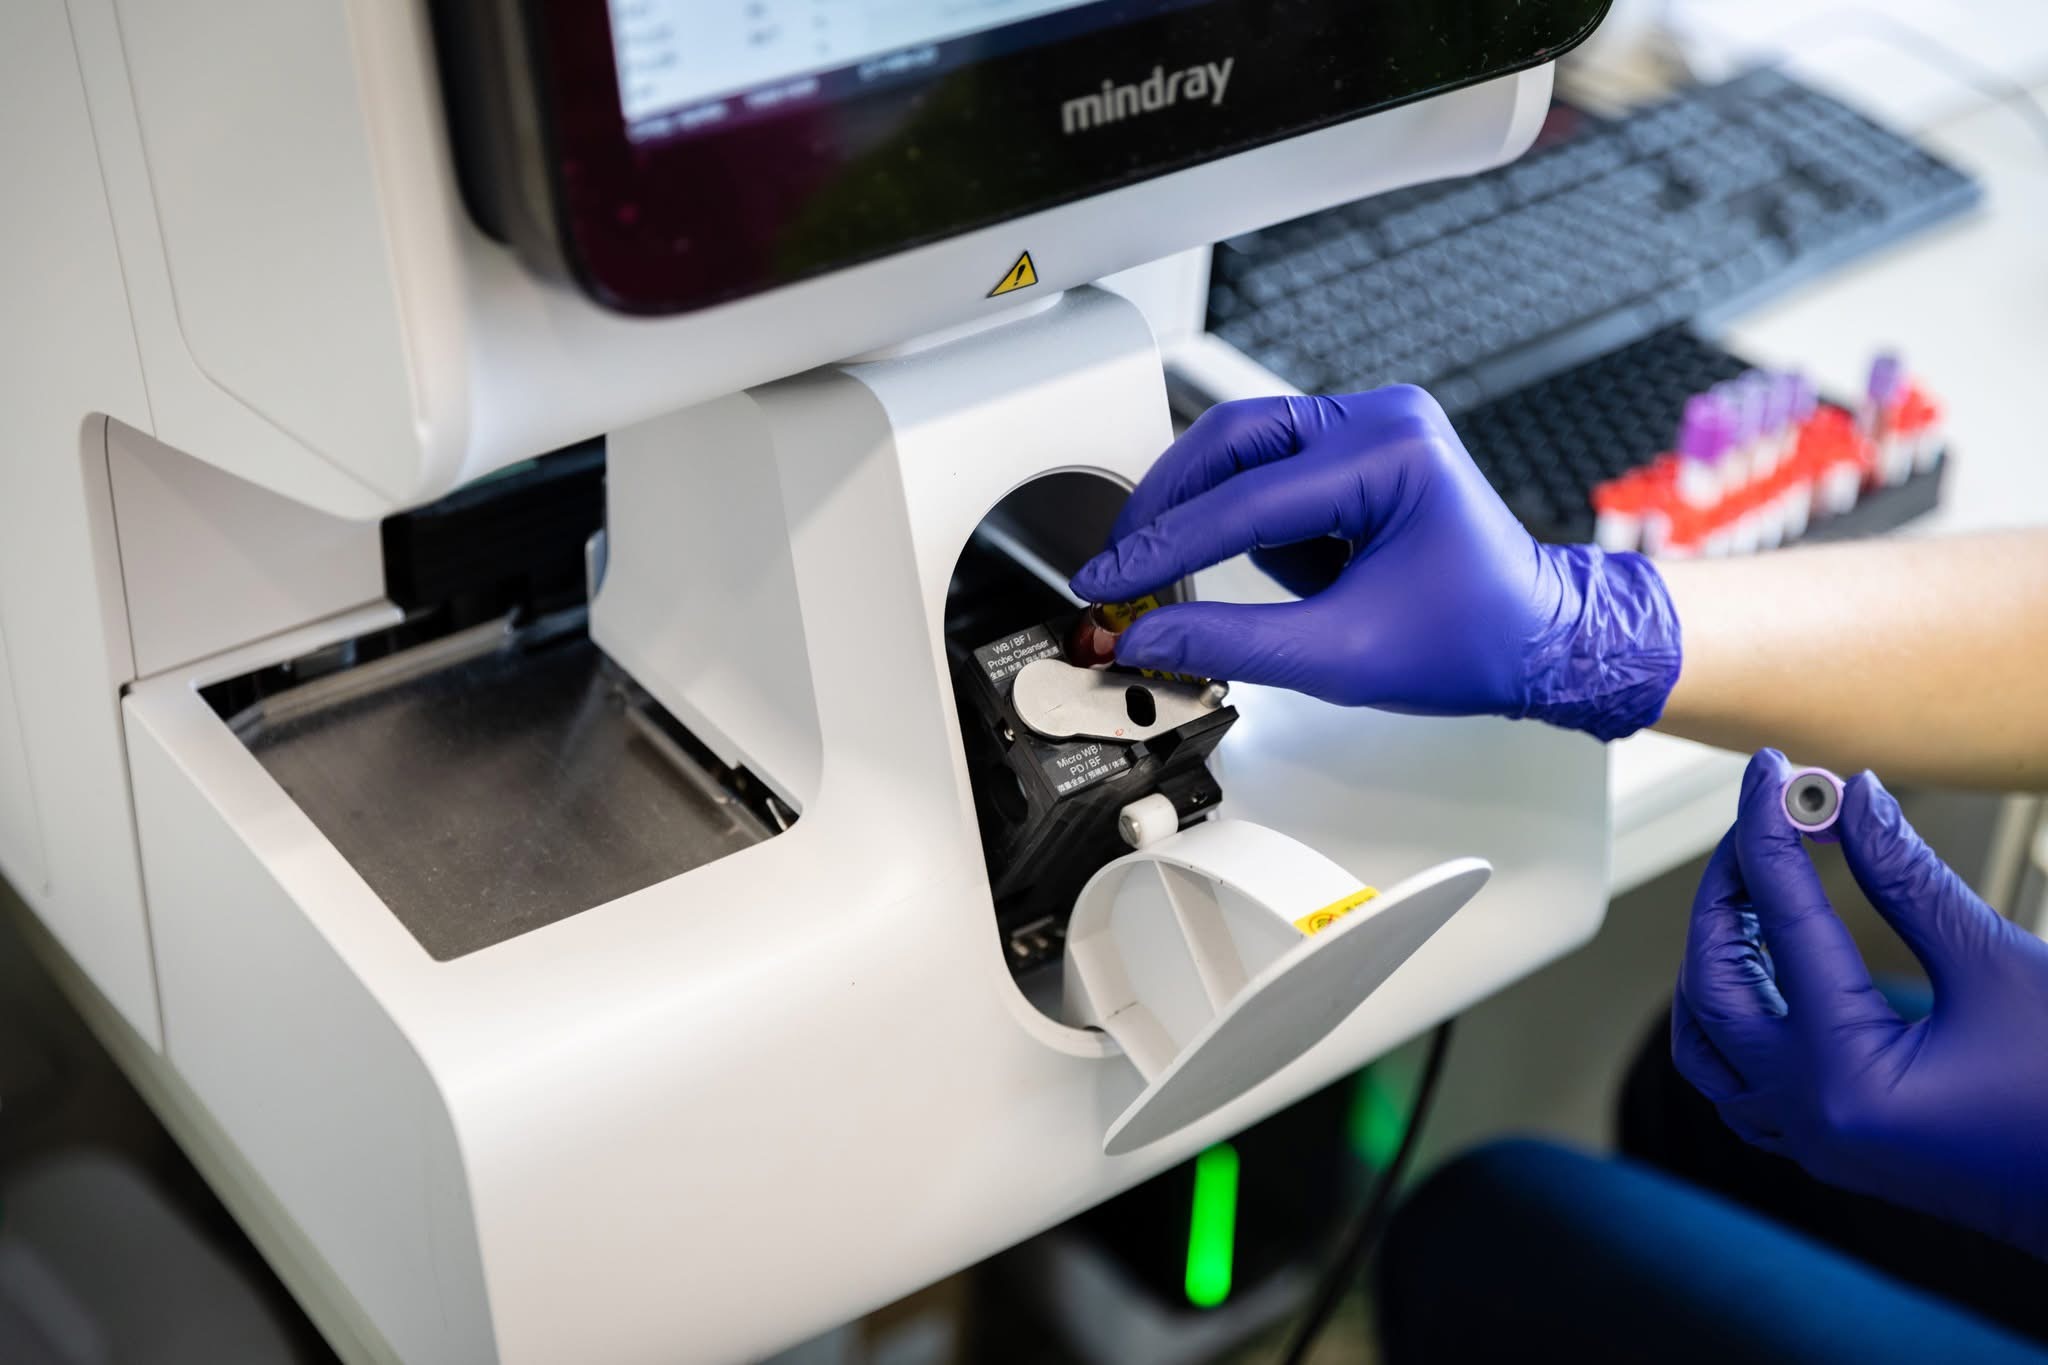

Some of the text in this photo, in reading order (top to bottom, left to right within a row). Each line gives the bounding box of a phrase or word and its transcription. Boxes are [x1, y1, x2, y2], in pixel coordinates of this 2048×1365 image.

[1062, 57, 1235, 134] mindray
[987, 639, 1049, 670] Probe Cleanser
[992, 643, 1010, 654] WB
[1013, 635, 1025, 646] BF
[1056, 753, 1083, 768] Micro
[1081, 745, 1098, 757] WB
[1069, 764, 1085, 776] PD
[1088, 755, 1101, 767] BF
